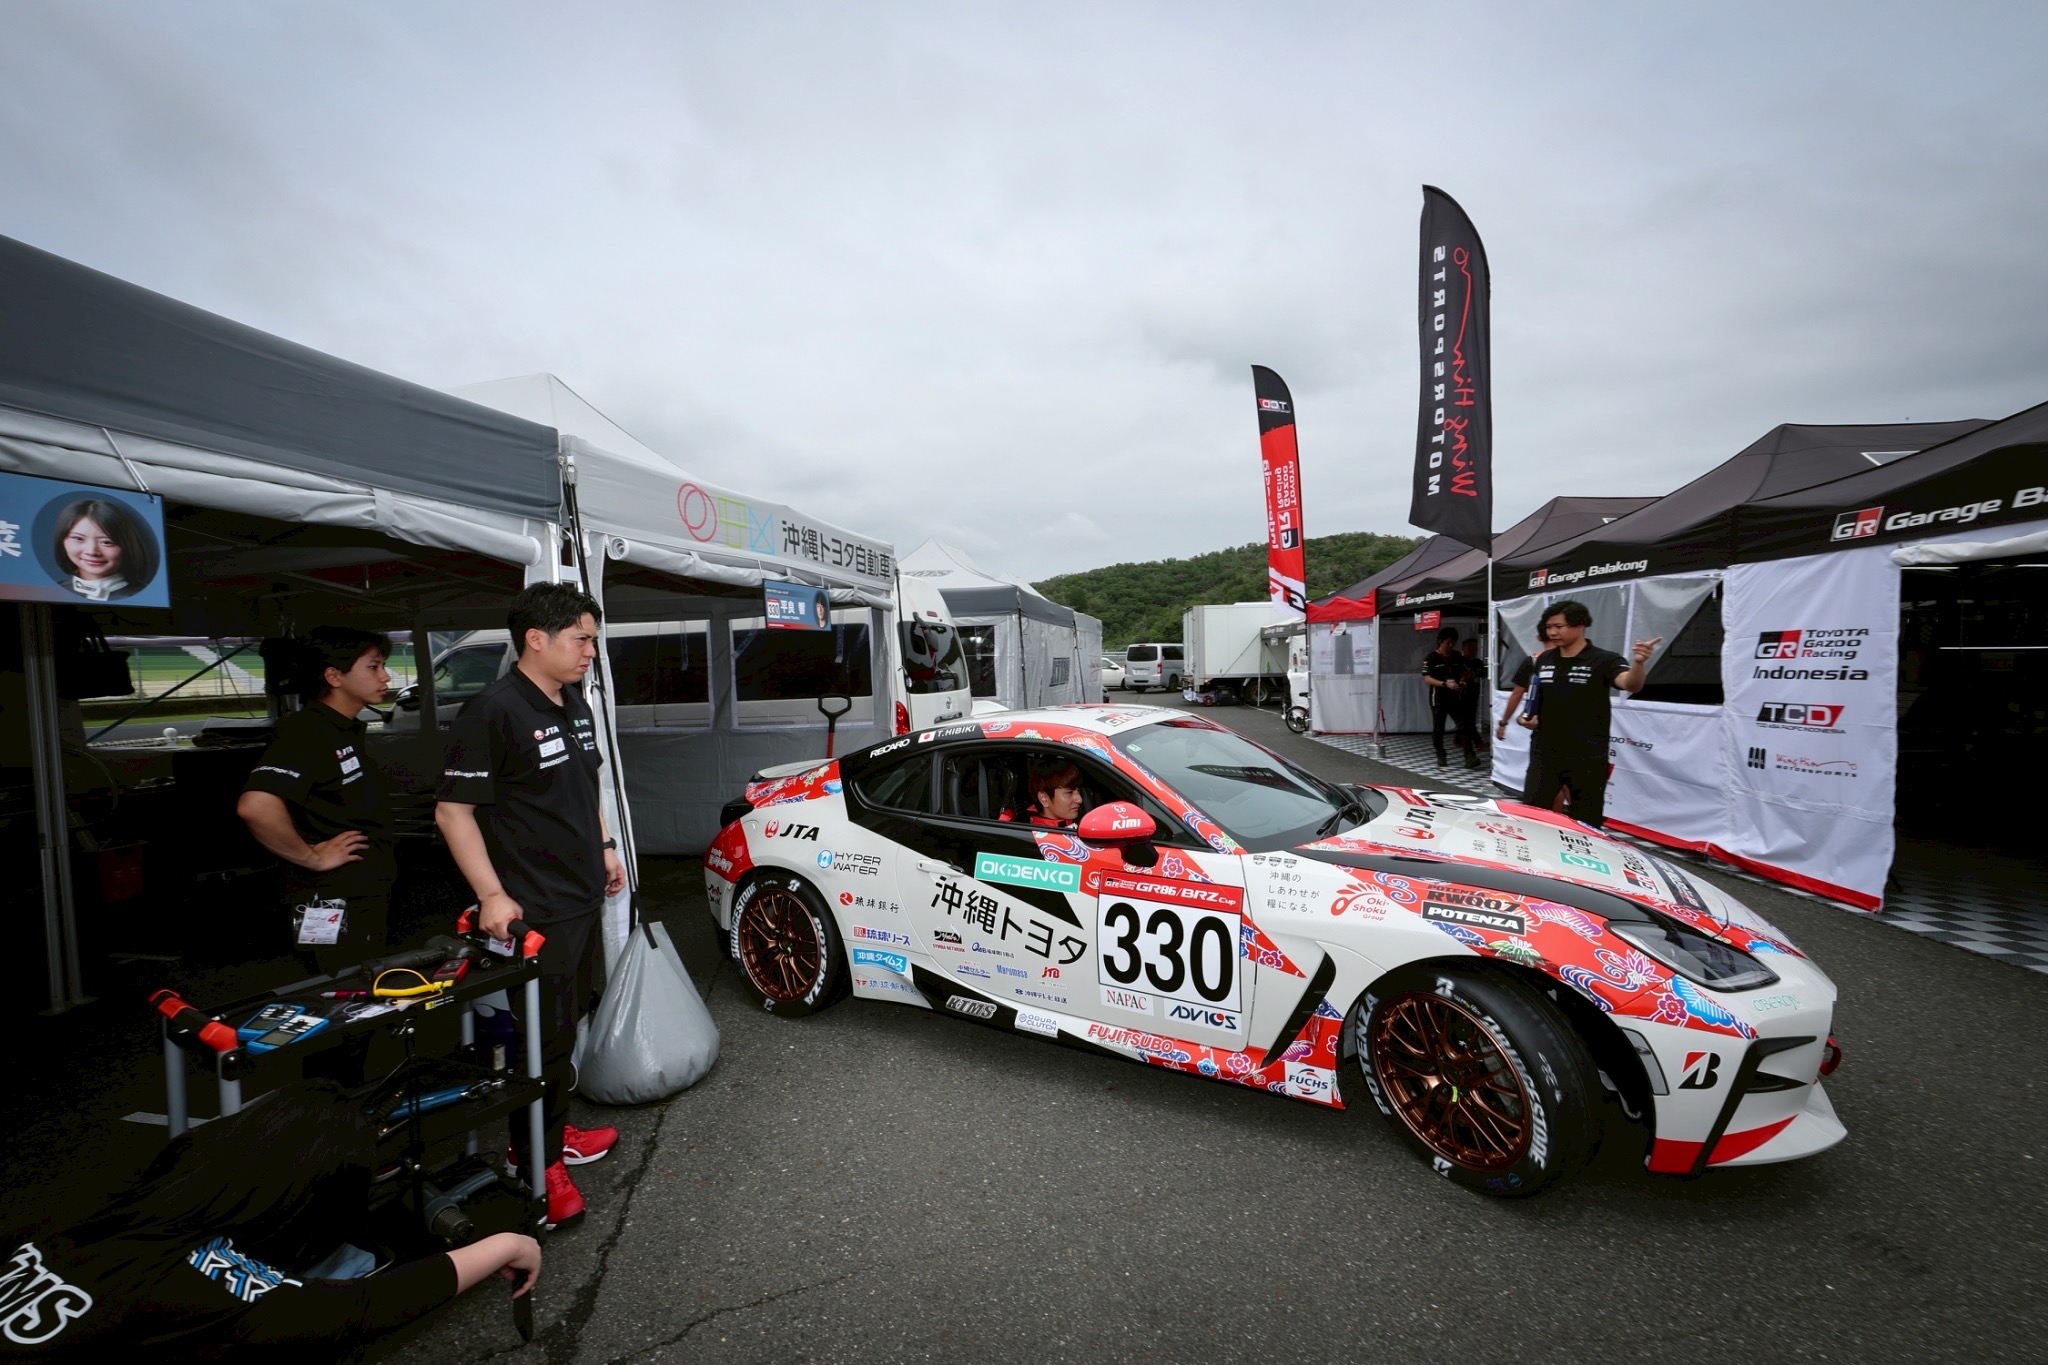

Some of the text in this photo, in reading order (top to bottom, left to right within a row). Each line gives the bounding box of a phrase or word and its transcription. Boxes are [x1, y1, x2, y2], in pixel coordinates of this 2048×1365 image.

[1835, 519, 1878, 539] GR
[1885, 499, 2003, 531] Garage
[782, 520, 891, 580] 沖縄トヨタ自動車
[1529, 560, 1649, 588] GR Garage Balakong
[1405, 596, 1426, 605] Garage
[1425, 591, 1455, 601] Balakong
[1806, 628, 1869, 639] TOYOTA
[1755, 639, 1862, 659] GR GAZOO
[1801, 649, 1858, 661] Racing
[1752, 665, 1870, 681] Indonesia
[1763, 703, 1832, 726] TCD
[544, 725, 560, 737] JTA
[937, 725, 976, 738] T.HIBIKI
[869, 738, 911, 759] RECARO
[1626, 737, 1654, 751] Racing
[1775, 764, 1858, 778] MOTORSPORTS
[1404, 808, 1436, 829] JTA
[779, 823, 820, 841] JTA
[834, 851, 881, 866] HYPER
[1269, 871, 1301, 883] 沖縄の
[1268, 884, 1320, 899] しあわせが
[1427, 884, 1486, 898] POTENZA
[855, 896, 900, 914] 琉球銀行
[1218, 897, 1237, 906] Cup
[1352, 903, 1387, 916] Shoku
[1366, 897, 1390, 907] Oki-
[730, 881, 758, 960] BRIDGESTONE
[931, 875, 1088, 965] 沖縄トヨタ
[1363, 914, 1384, 922] Group
[1427, 906, 1519, 930] POTENZA
[866, 928, 911, 946] 琉球リース
[803, 916, 828, 1006] POTENZA
[856, 951, 904, 969] 沖縄タイムス
[1103, 902, 1234, 1003] 330
[1107, 990, 1148, 1010] NAPAC
[1026, 1019, 1057, 1032] CLUTCH
[1027, 1014, 1057, 1026] OGURA
[1170, 1005, 1237, 1030] ADVICS
[1088, 1023, 1174, 1053] FUJITSUBO
[1355, 993, 1392, 1116] POTENZA
[1288, 1074, 1329, 1090] FUCHS
[1483, 1015, 1549, 1171] BRIDGESTONE
